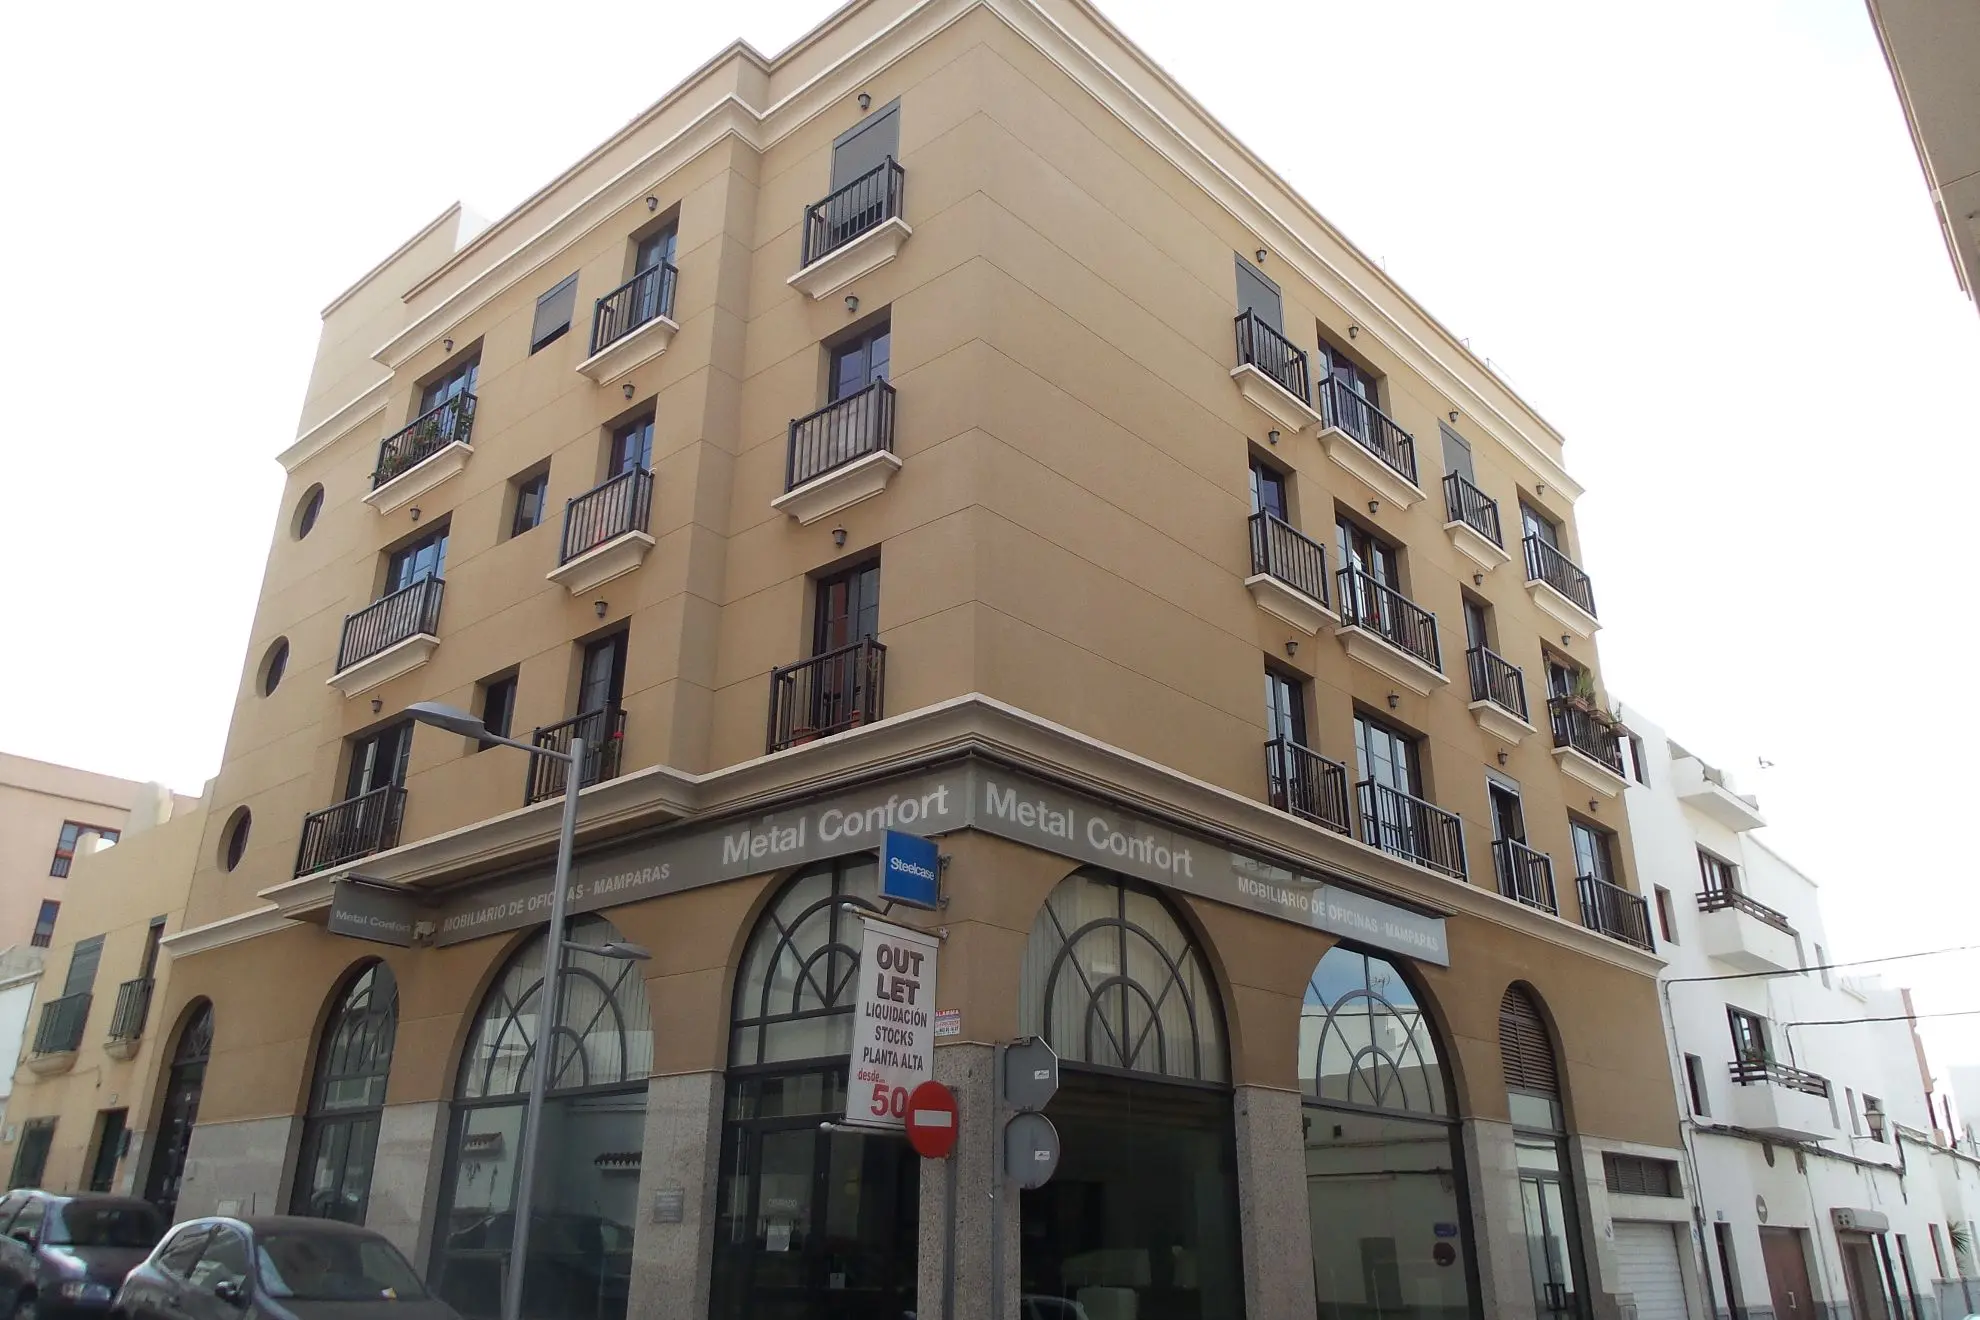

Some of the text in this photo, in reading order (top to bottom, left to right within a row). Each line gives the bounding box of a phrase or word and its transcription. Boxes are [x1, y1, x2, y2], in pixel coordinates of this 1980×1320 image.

[723, 784, 949, 865] Metal Confort
[986, 781, 1194, 878] Metal Confort
[890, 857, 935, 881] Steelcase
[443, 904, 506, 932] MOBILIARIO
[509, 899, 524, 916] DE
[527, 883, 585, 911] OFICAS
[593, 863, 671, 896] MAMPARAS
[1238, 876, 1309, 912] MOBILIARIO
[1311, 897, 1326, 917] DE
[1328, 906, 1378, 934] OFICINAS
[1385, 921, 1439, 952] MAMPARAS
[335, 910, 368, 925] Metal
[876, 943, 925, 977] OUT
[876, 972, 921, 1006] LET
[865, 1001, 928, 1029] LIQUIDACIÓN
[875, 1025, 914, 1047] STOCKS
[863, 1046, 924, 1071] PLANTA ALTA
[870, 1083, 909, 1118] 50
